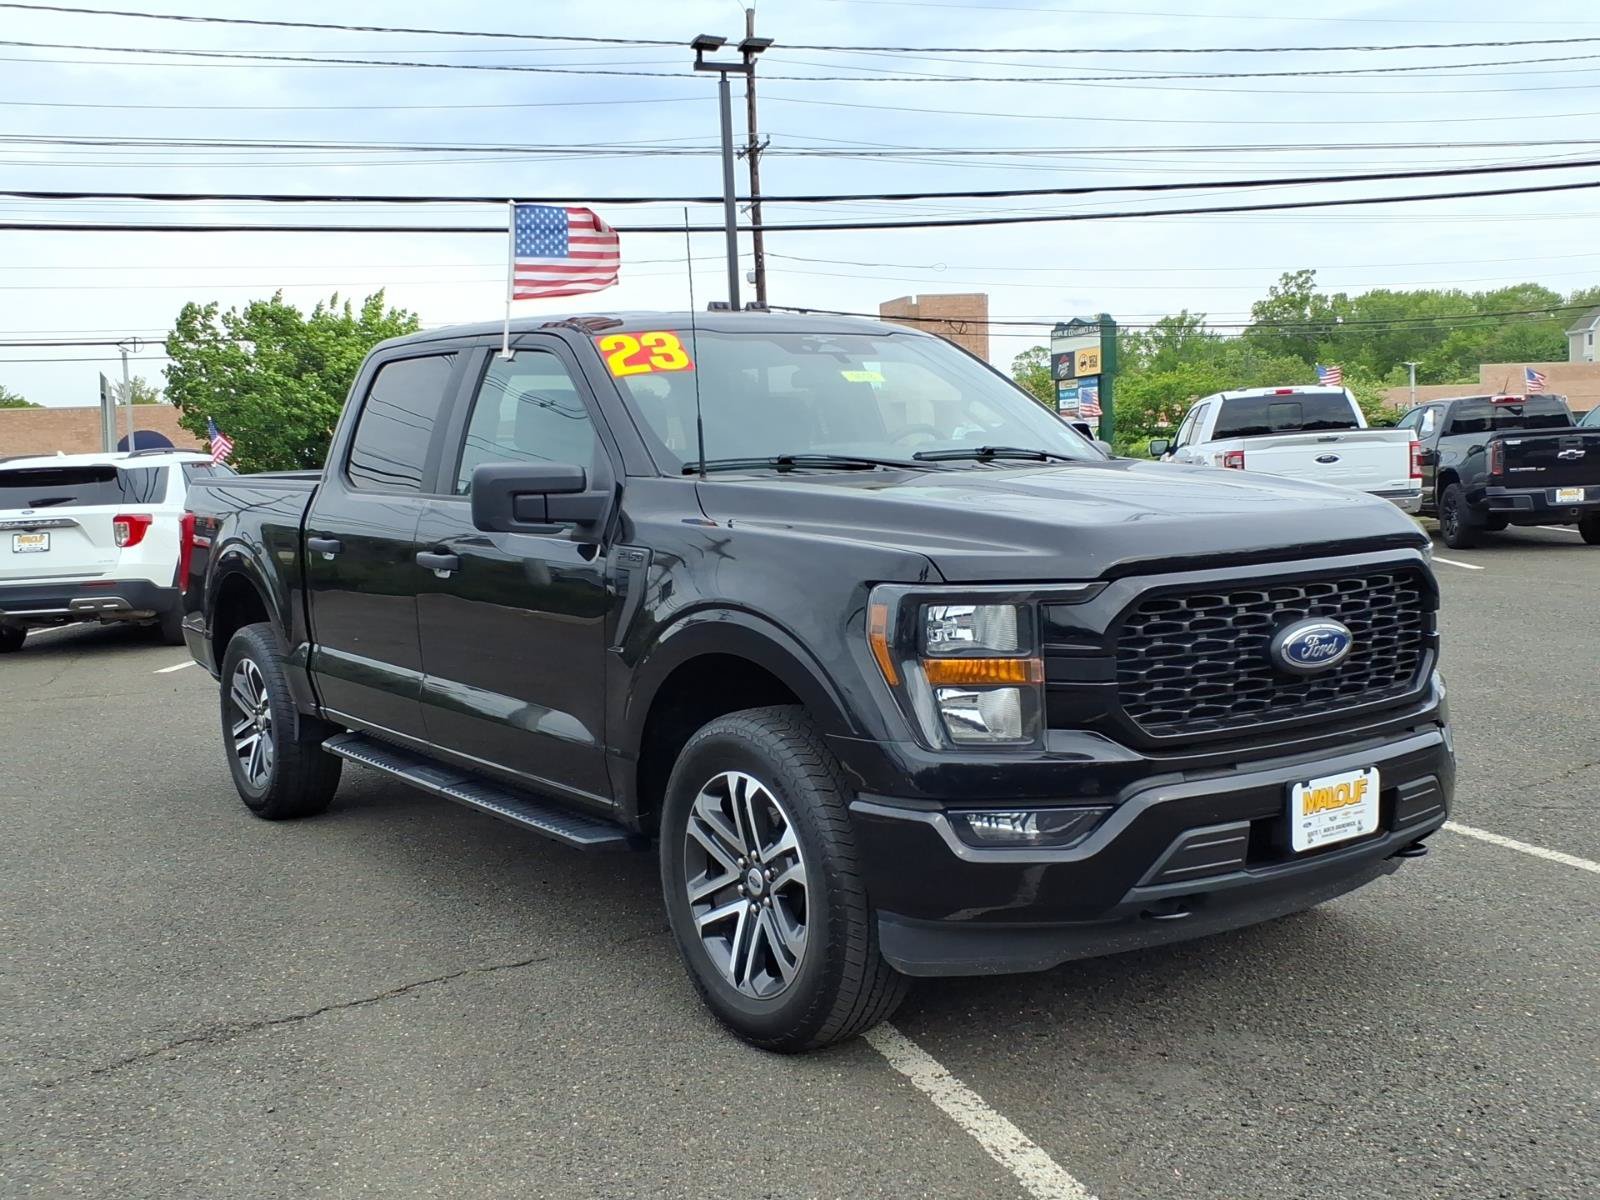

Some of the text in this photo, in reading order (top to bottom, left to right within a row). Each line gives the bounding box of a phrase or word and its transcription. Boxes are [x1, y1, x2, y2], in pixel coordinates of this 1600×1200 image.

[600, 331, 689, 377] 23
[1301, 633, 1338, 659] Ford
[1302, 779, 1368, 816] MALOUF
